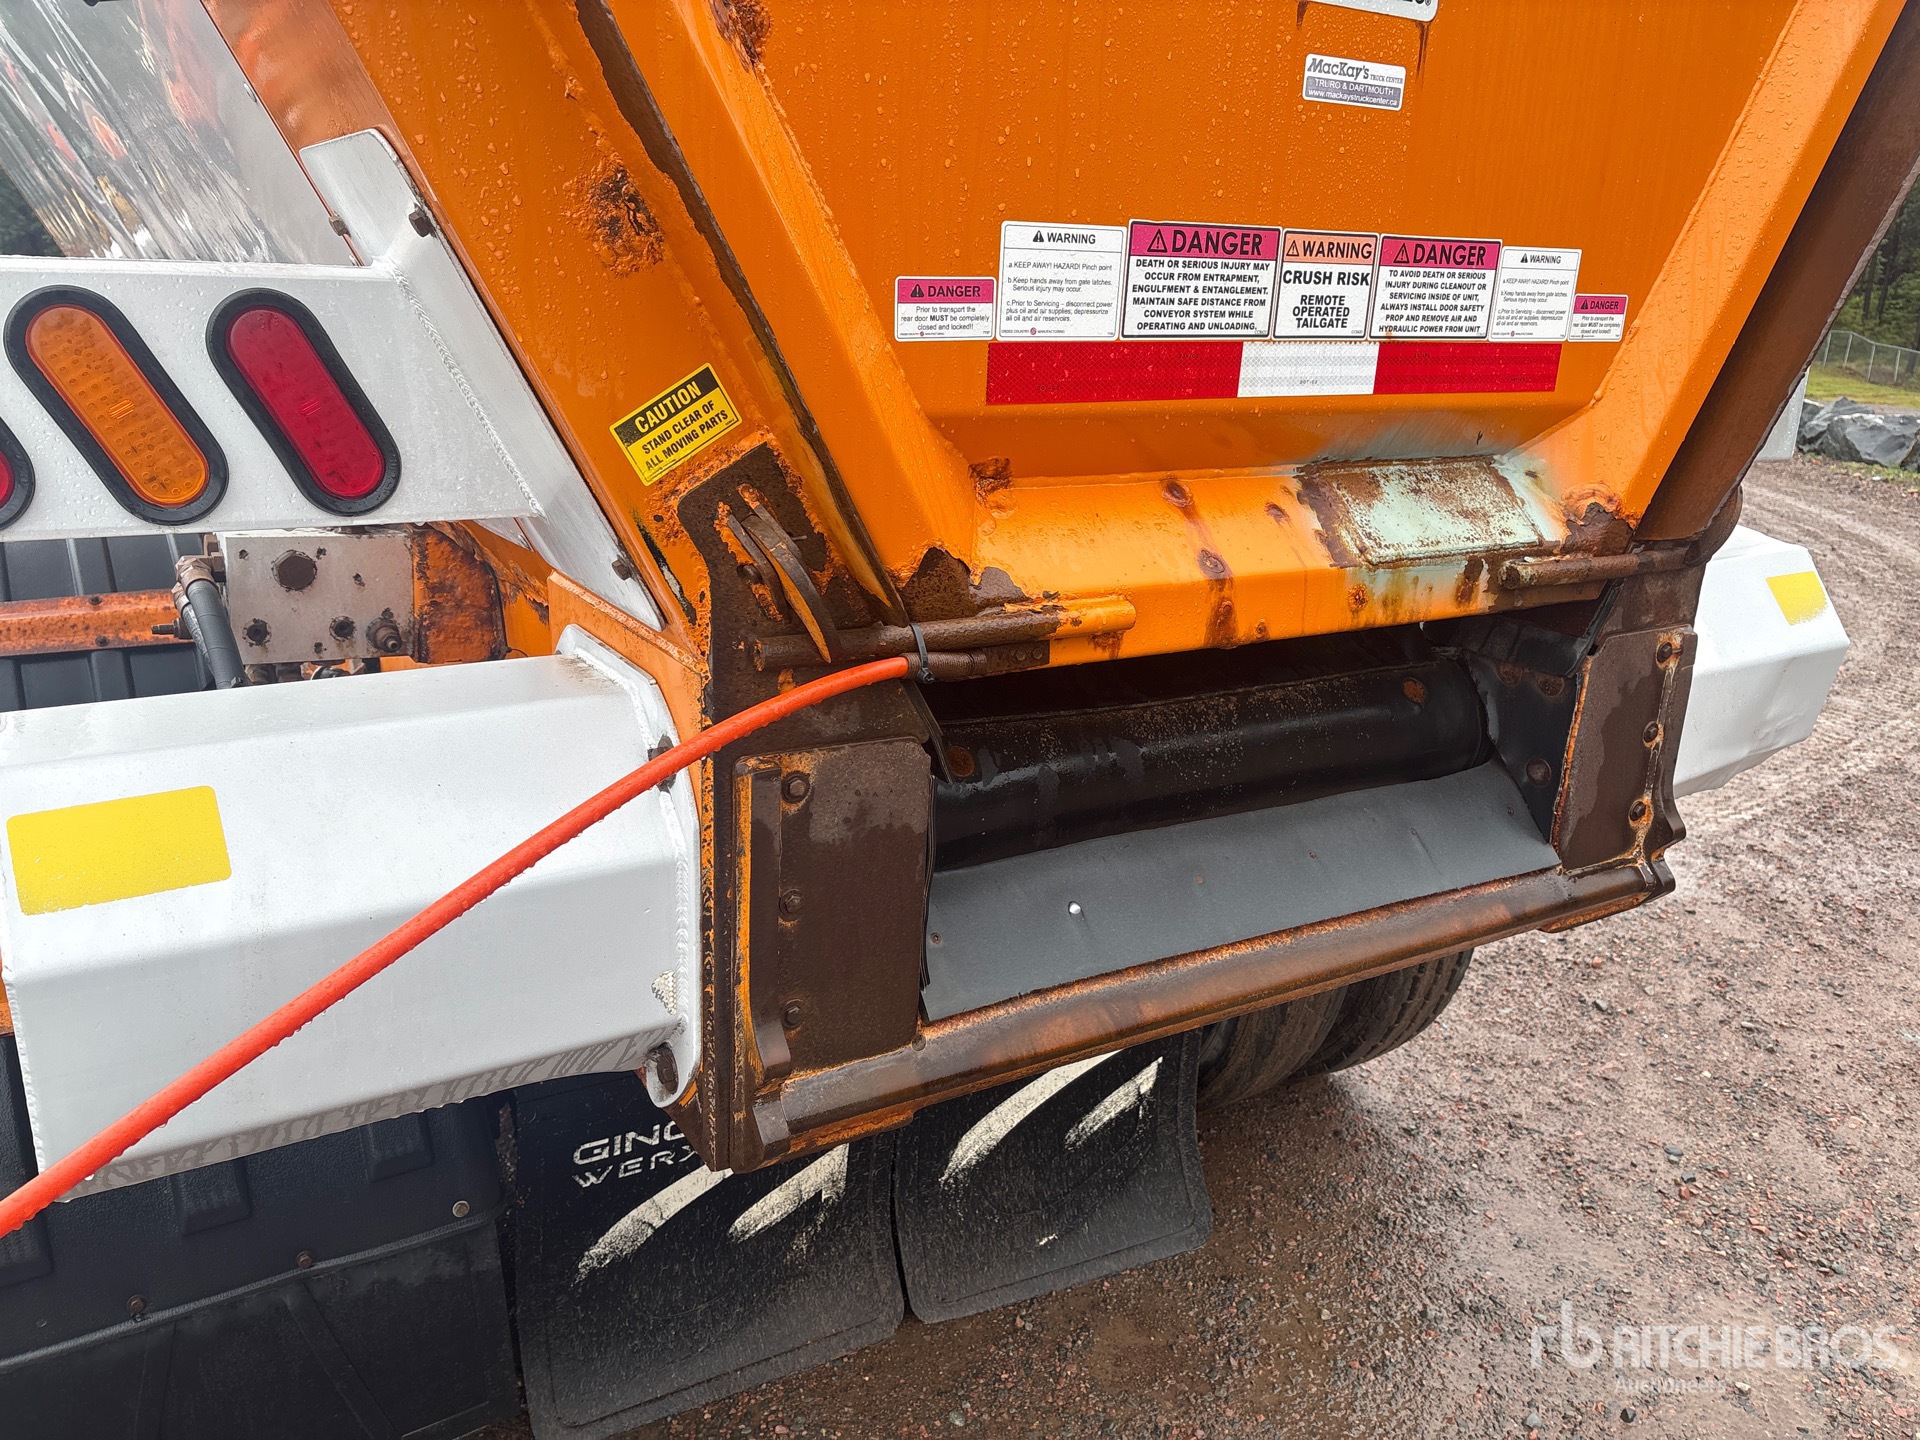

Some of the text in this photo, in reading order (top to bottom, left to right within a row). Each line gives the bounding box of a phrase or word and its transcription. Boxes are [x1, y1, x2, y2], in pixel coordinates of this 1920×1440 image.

[1307, 58, 1369, 80] MacKay's
[1370, 74, 1403, 84] TRUCK CENTER
[1315, 79, 1340, 89] TRURO
[1349, 84, 1394, 95] DARTMOUTH
[1308, 89, 1398, 106] www.mackaystruckcenter.ca
[1047, 232, 1096, 244] WARNING
[1172, 230, 1262, 255] DANGER
[1303, 240, 1372, 259] WARNING
[1413, 244, 1486, 266] DANGER
[1136, 259, 1270, 271] DEATH OR SERIOUS INJURY MAY
[1530, 255, 1561, 264] WARNING
[1145, 272, 1259, 284] OCCUR FROM ENTRAPMENT,
[1283, 270, 1370, 286] CRUSH RISK
[1400, 270, 1421, 278] AVOID
[1423, 271, 1445, 279] DEATH
[1446, 271, 1456, 279] OR
[1457, 272, 1486, 280] SERIOUS
[1036, 284, 1051, 293] injury
[1132, 284, 1268, 295] ENGULFMENT & ENTANGLEMENT.
[1385, 281, 1411, 289] INJURY
[1412, 282, 1438, 290] DURING
[1440, 282, 1475, 290] CLEANOUT
[928, 286, 980, 297] DANGER
[1389, 292, 1479, 302] SERVICING INSIDE OF UNIT,
[1034, 300, 1059, 308] Servicing
[1133, 297, 1175, 305] MAINTAIN
[1178, 298, 1198, 306] SAFE
[1201, 298, 1241, 306] DISTANCE
[1300, 295, 1345, 306] REMOTE
[1590, 301, 1619, 309] DANGER
[939, 306, 965, 314] transport
[1006, 307, 1018, 315] plus
[1292, 306, 1350, 317] OPERATED
[1380, 303, 1408, 311] ALWAYS
[1144, 310, 1253, 318] CONVEYOR SYSTEM WHILE
[1406, 314, 1419, 322] AND
[1137, 322, 1257, 330] OPERATING AND UNLOADING.
[1296, 318, 1348, 328] TAILGATE
[635, 381, 701, 433] CAUTION
[642, 400, 715, 454] STAND CLEAR OF
[645, 456, 663, 470] ALL
[662, 429, 699, 459] MOVING
[699, 410, 728, 434] PARTS
